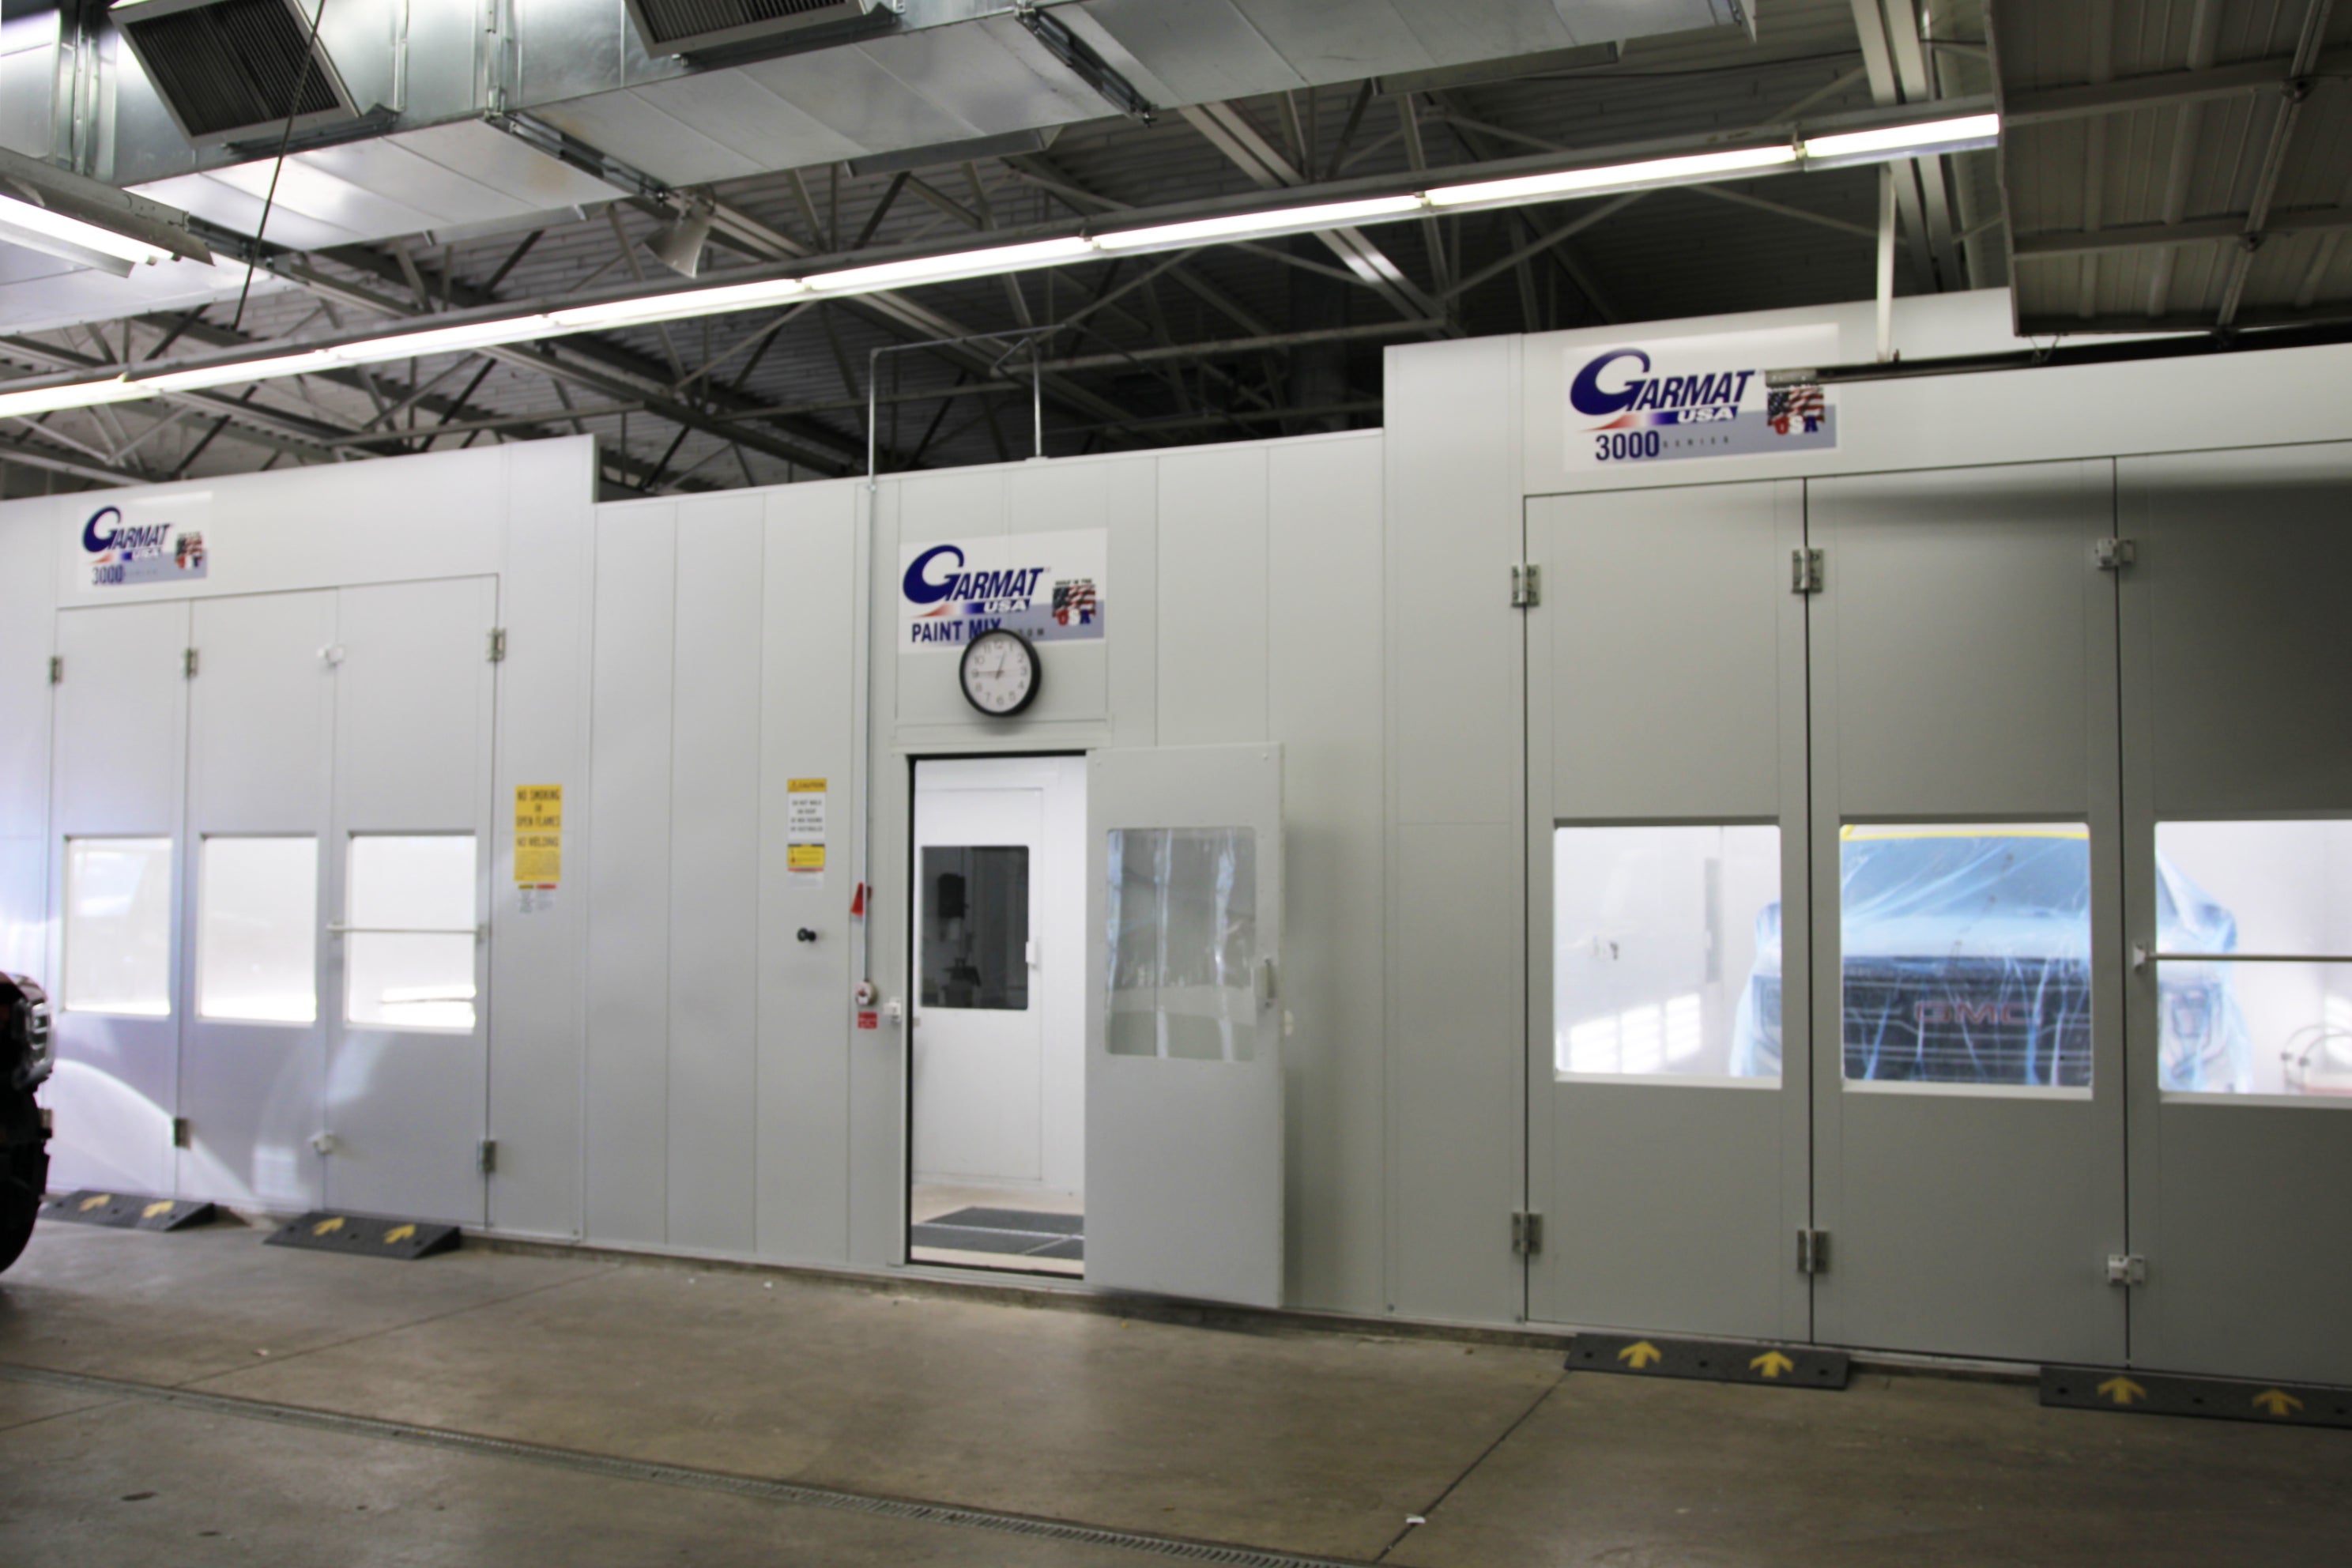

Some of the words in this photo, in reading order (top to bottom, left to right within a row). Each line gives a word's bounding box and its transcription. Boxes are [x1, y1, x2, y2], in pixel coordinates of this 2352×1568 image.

[1570, 348, 1756, 416] GARMAT
[1677, 407, 1734, 424] USA
[1595, 431, 1660, 461] 3000
[82, 506, 173, 552] GARMAT
[92, 564, 123, 586] 3000
[903, 545, 1045, 605] GARMAT
[983, 599, 1027, 613] USA
[911, 620, 963, 642] PAINT
[1914, 1001, 2042, 1025] GMC
